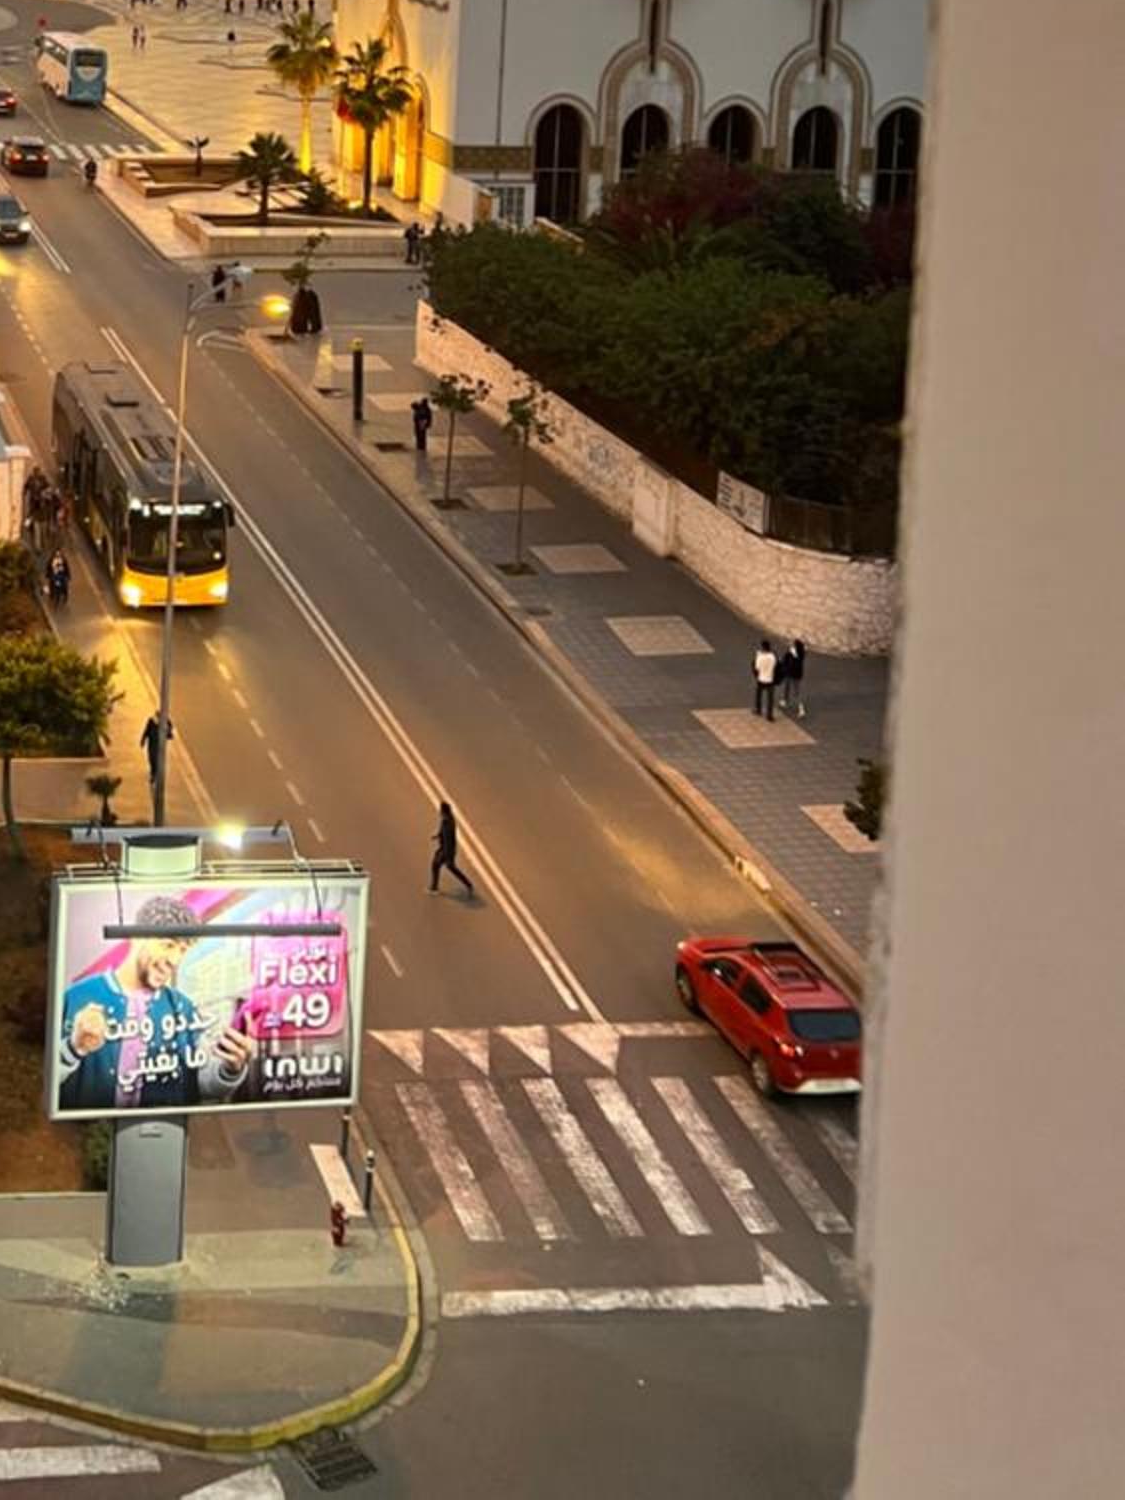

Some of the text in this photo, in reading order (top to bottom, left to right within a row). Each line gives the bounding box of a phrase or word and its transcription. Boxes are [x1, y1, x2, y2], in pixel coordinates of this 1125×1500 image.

[259, 956, 337, 986] Flexi
[282, 992, 330, 1028] 49
[185, 1044, 207, 1068] ما
[264, 1055, 343, 1078] inwi
